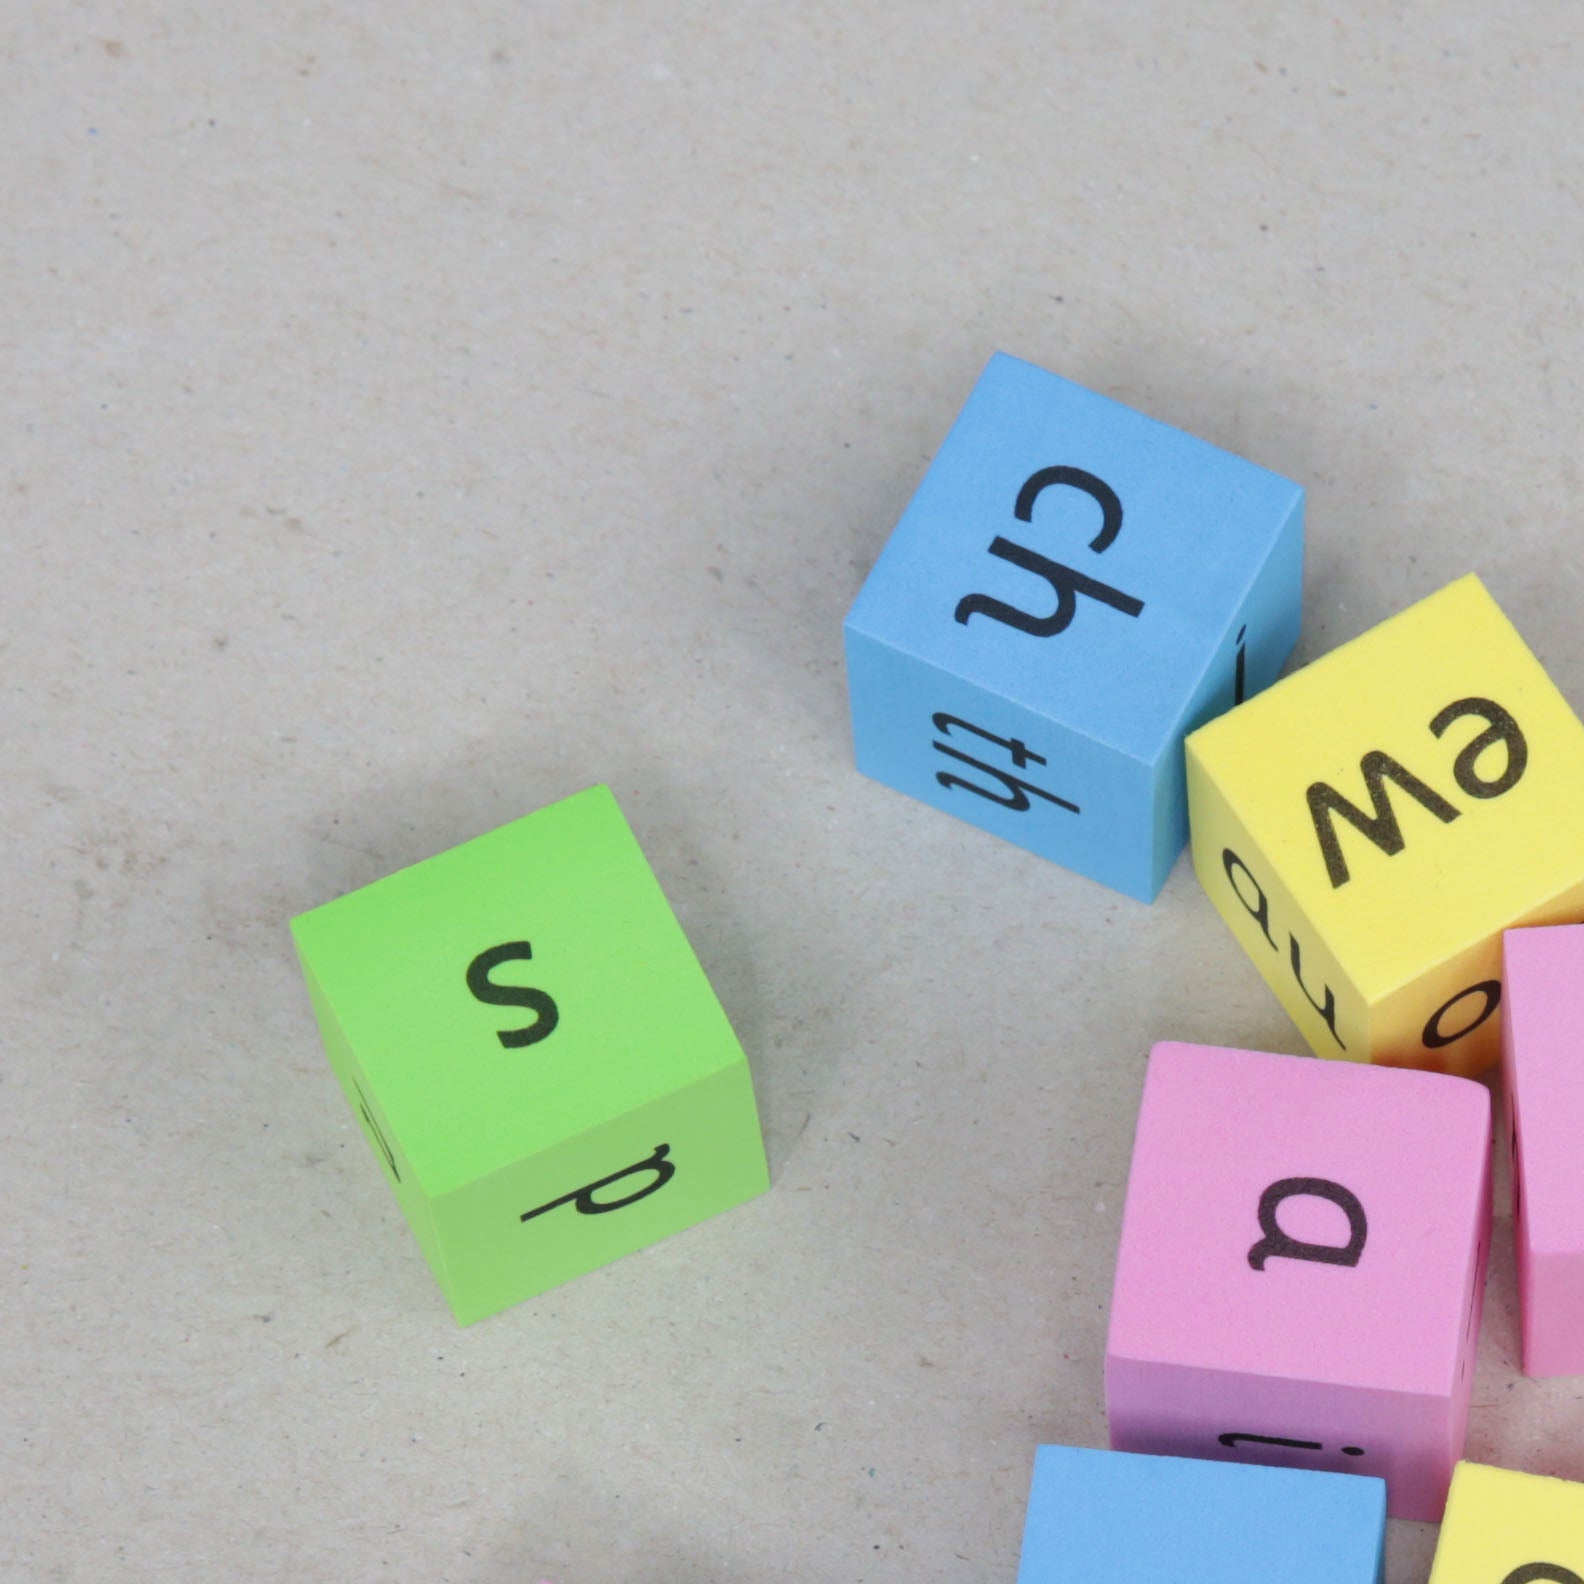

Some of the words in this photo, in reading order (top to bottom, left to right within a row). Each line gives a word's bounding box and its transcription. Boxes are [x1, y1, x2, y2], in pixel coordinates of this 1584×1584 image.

[956, 467, 1143, 636] ch
[932, 712, 1080, 813] th
[1307, 698, 1527, 887] ew
[467, 942, 558, 1047] s
[1249, 1178, 1366, 1270] a
